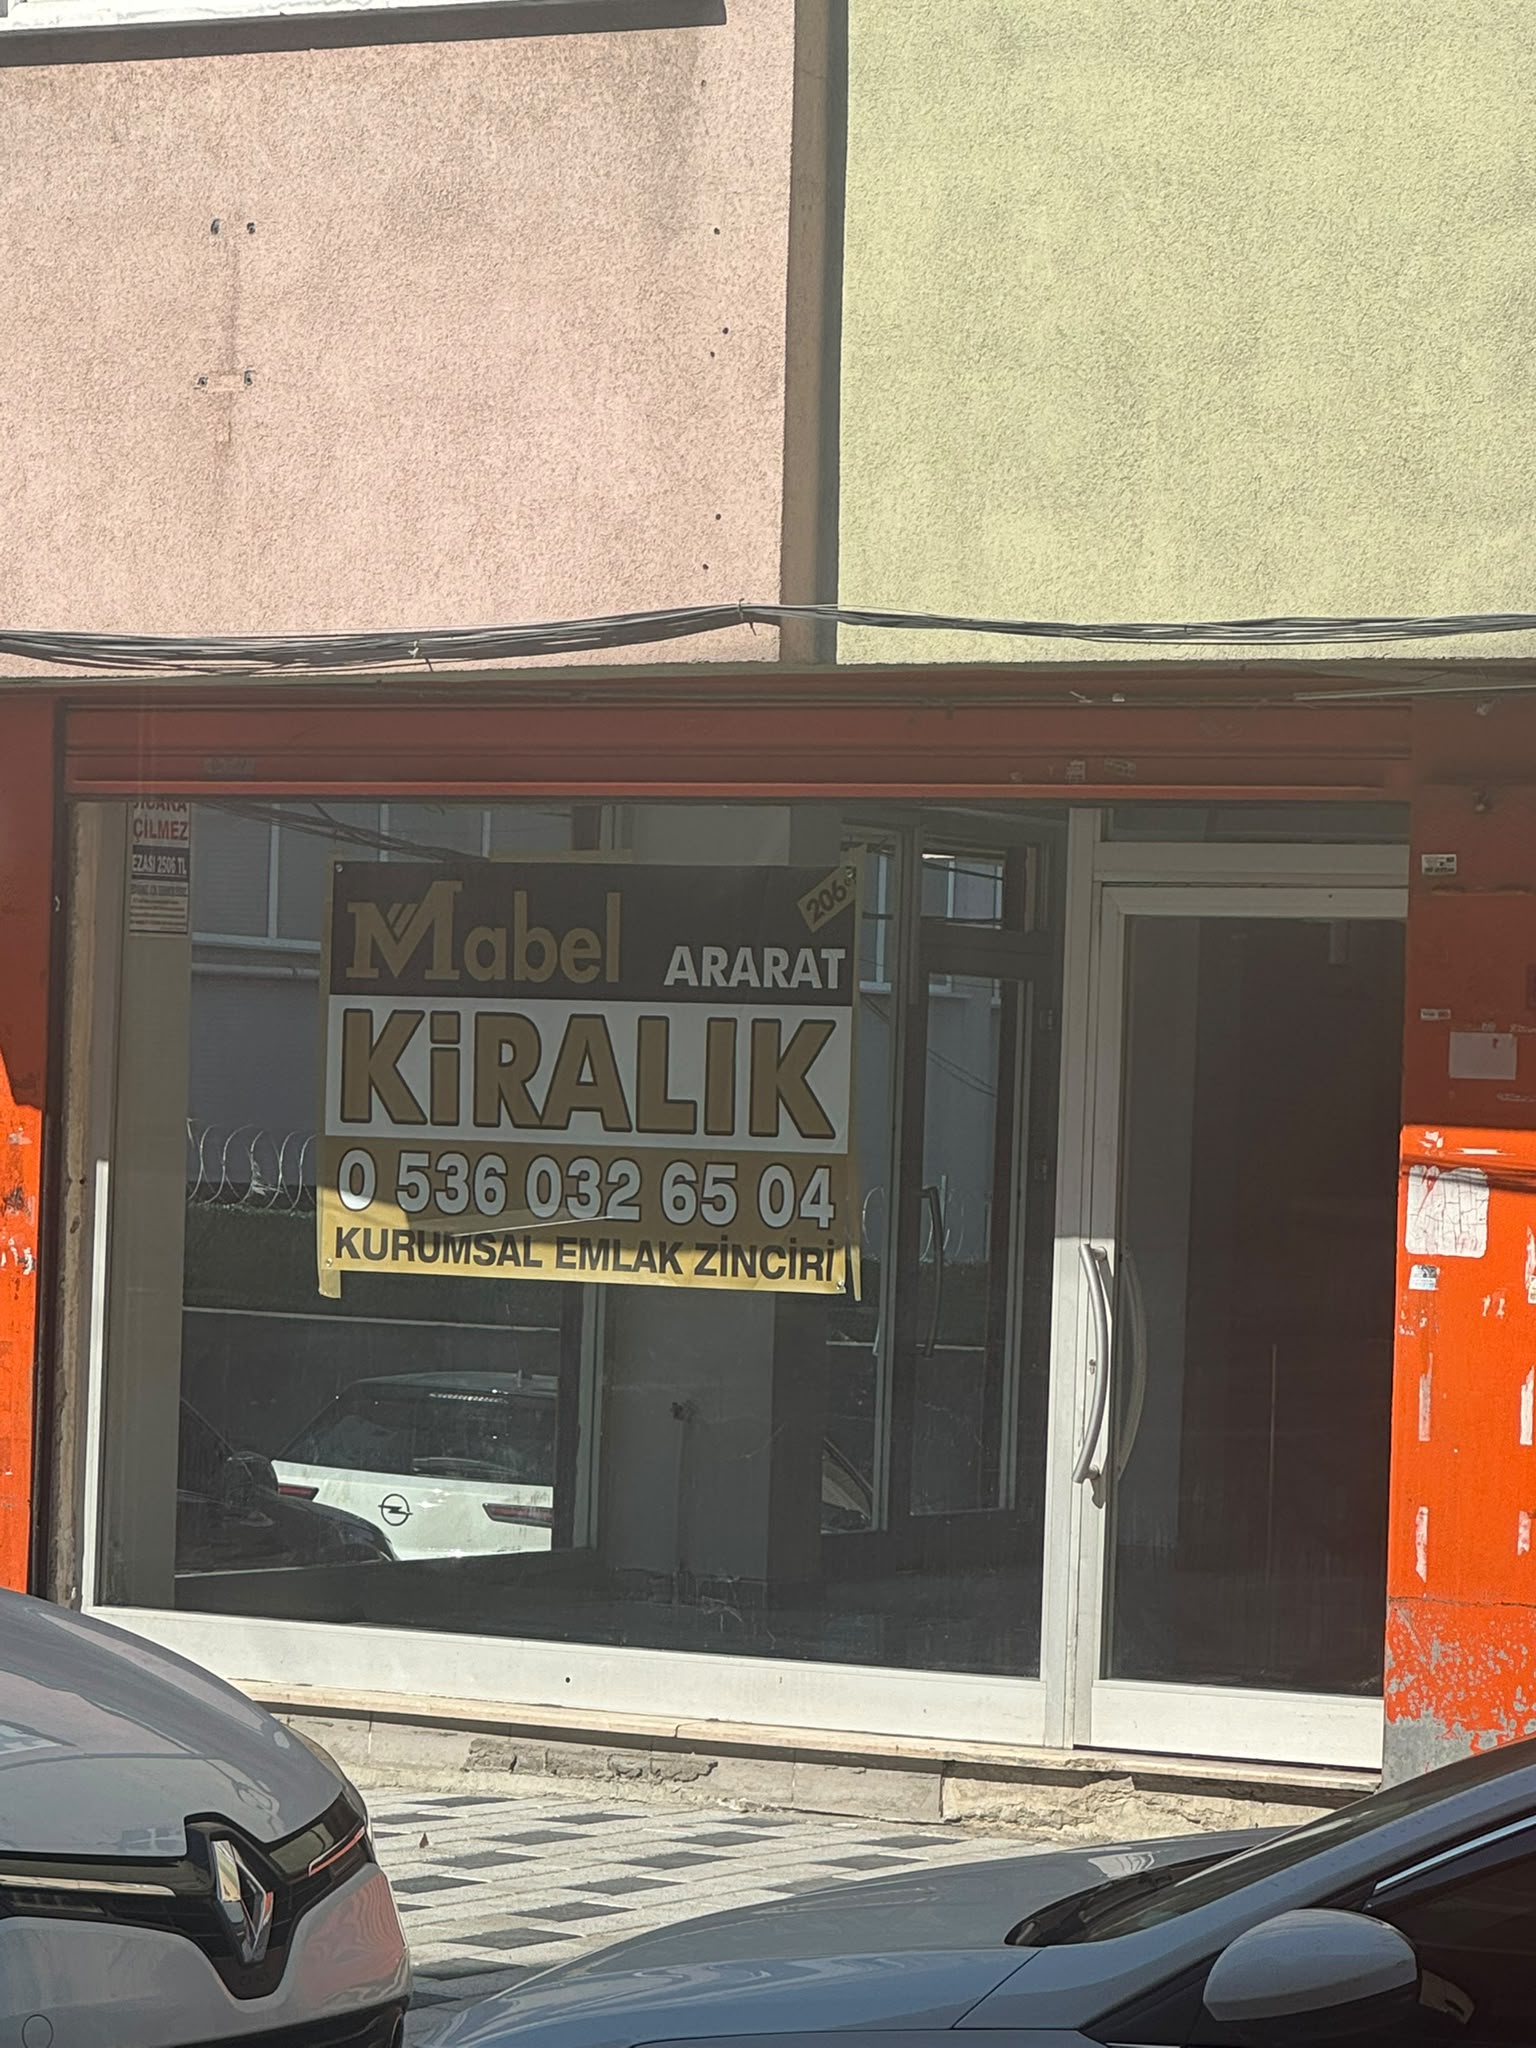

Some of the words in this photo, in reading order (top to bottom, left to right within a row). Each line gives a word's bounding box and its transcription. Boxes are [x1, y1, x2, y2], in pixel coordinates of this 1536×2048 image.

[346, 880, 621, 982] Mabel
[664, 945, 846, 989] ARARAT
[337, 1147, 377, 1212] 0
[396, 1151, 508, 1217] 536
[525, 1155, 642, 1221] 032
[660, 1160, 738, 1229] 65
[757, 1163, 836, 1230] 04
[335, 1226, 543, 1269] KURUMSAL
[556, 1236, 684, 1275] EMLAK
[693, 1234, 836, 1282] ZİNCİRİ
